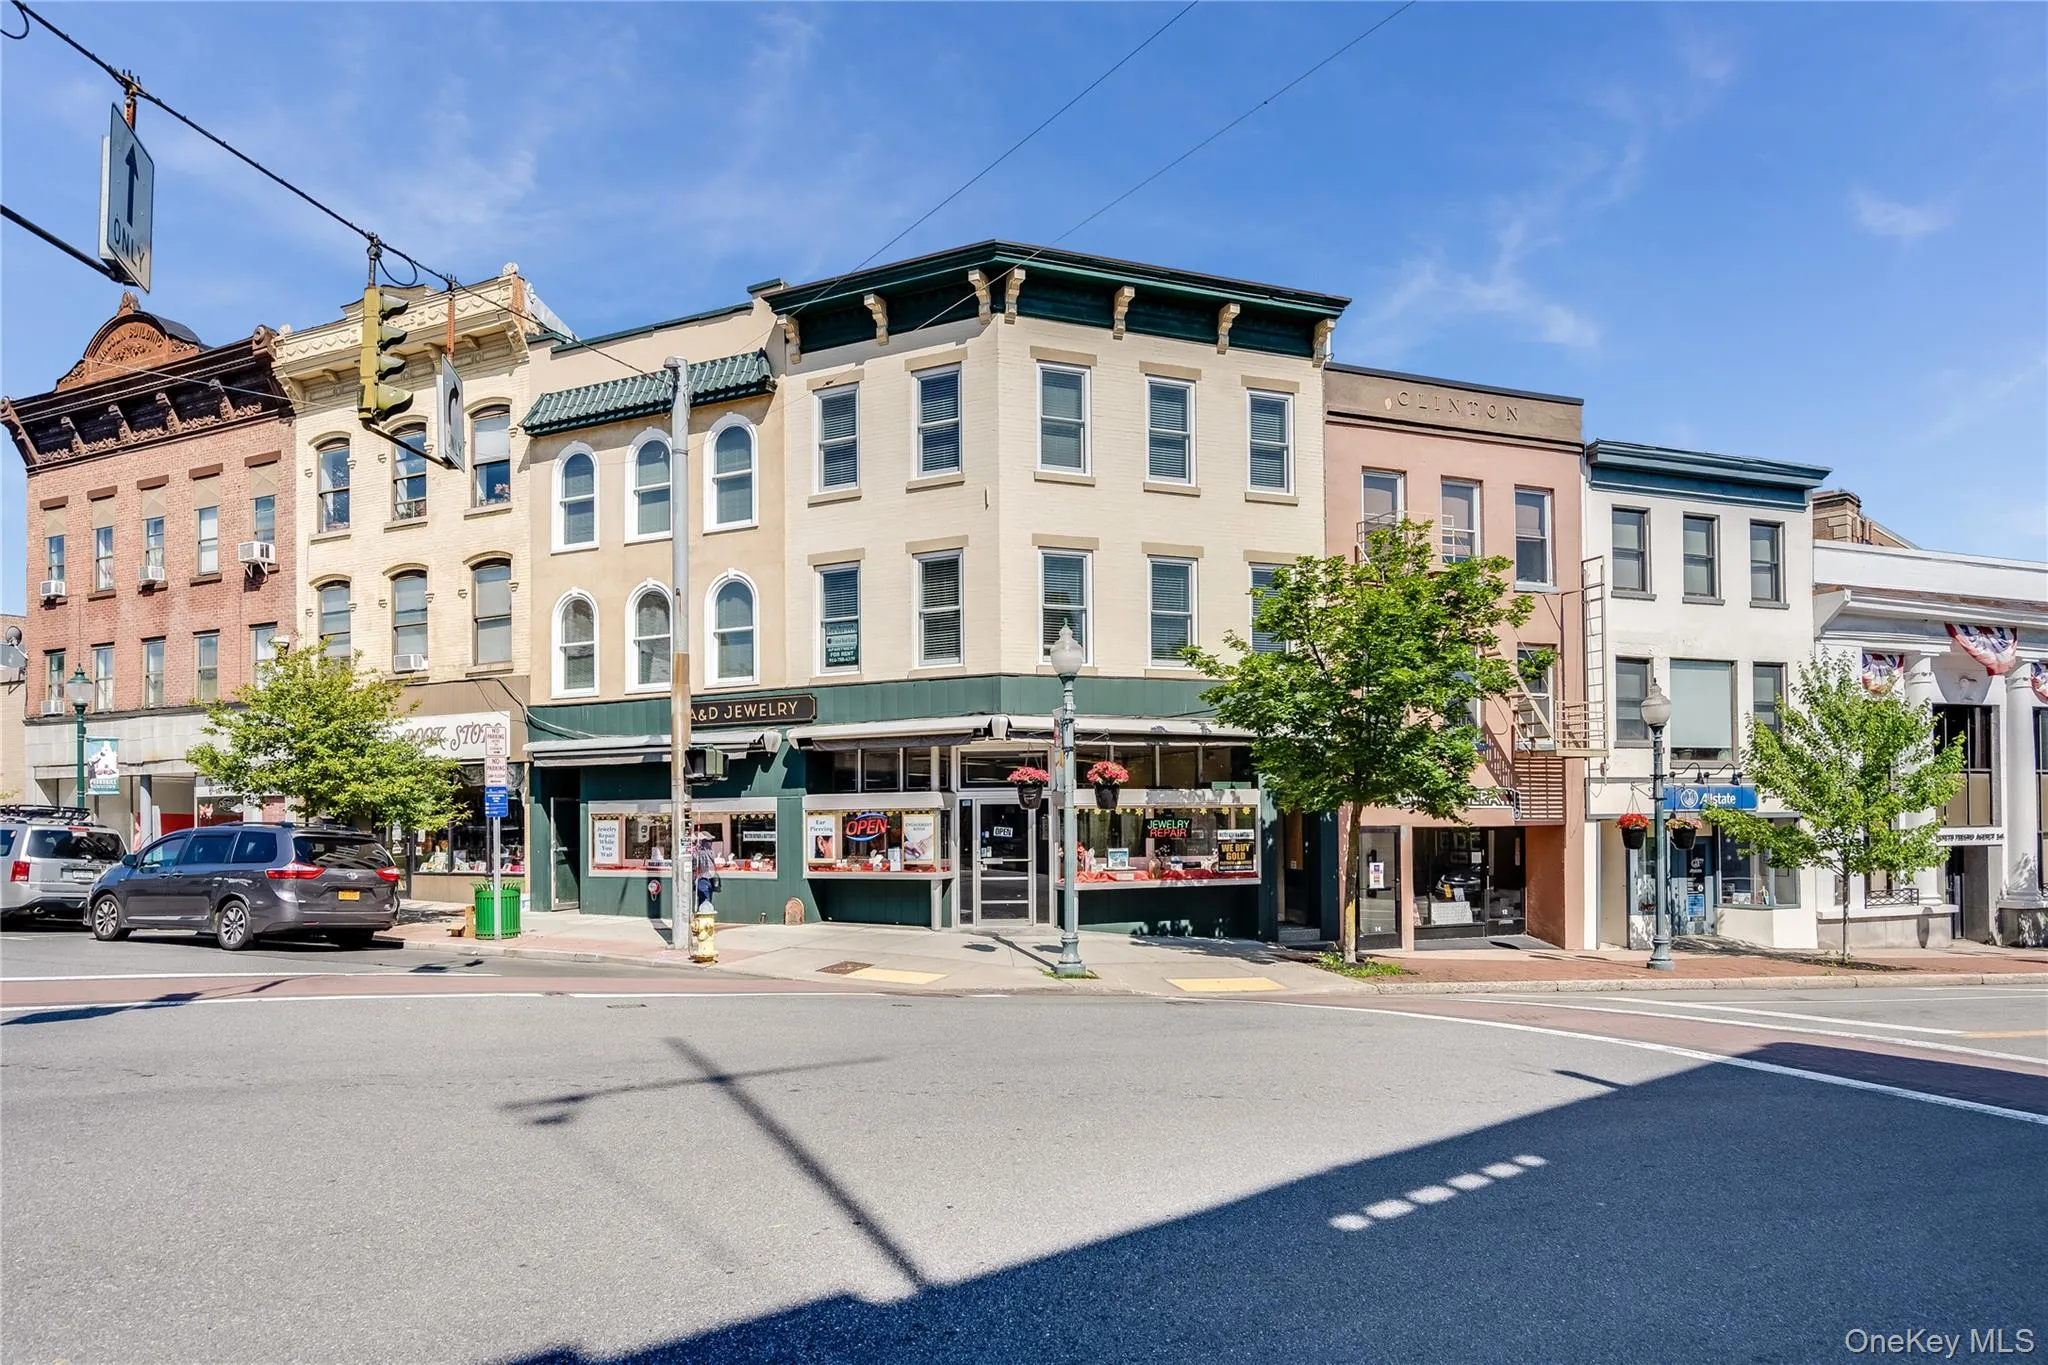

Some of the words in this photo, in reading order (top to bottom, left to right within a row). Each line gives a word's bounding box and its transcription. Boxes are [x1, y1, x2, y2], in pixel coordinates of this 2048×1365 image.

[114, 217, 145, 273] ONLY
[129, 326, 164, 348] BUILDING
[1397, 391, 1518, 422] CLINTON
[691, 706, 718, 721] A&D
[724, 701, 798, 719] JEWELRY
[450, 721, 502, 751] STO
[846, 819, 888, 835] OPEN
[994, 827, 1012, 836] OPEN
[1147, 820, 1189, 829] JEWELRY
[1150, 829, 1187, 837] REPAIR
[1221, 843, 1234, 852] WE
[1235, 843, 1250, 852] BUY
[1226, 852, 1246, 860] GOLD
